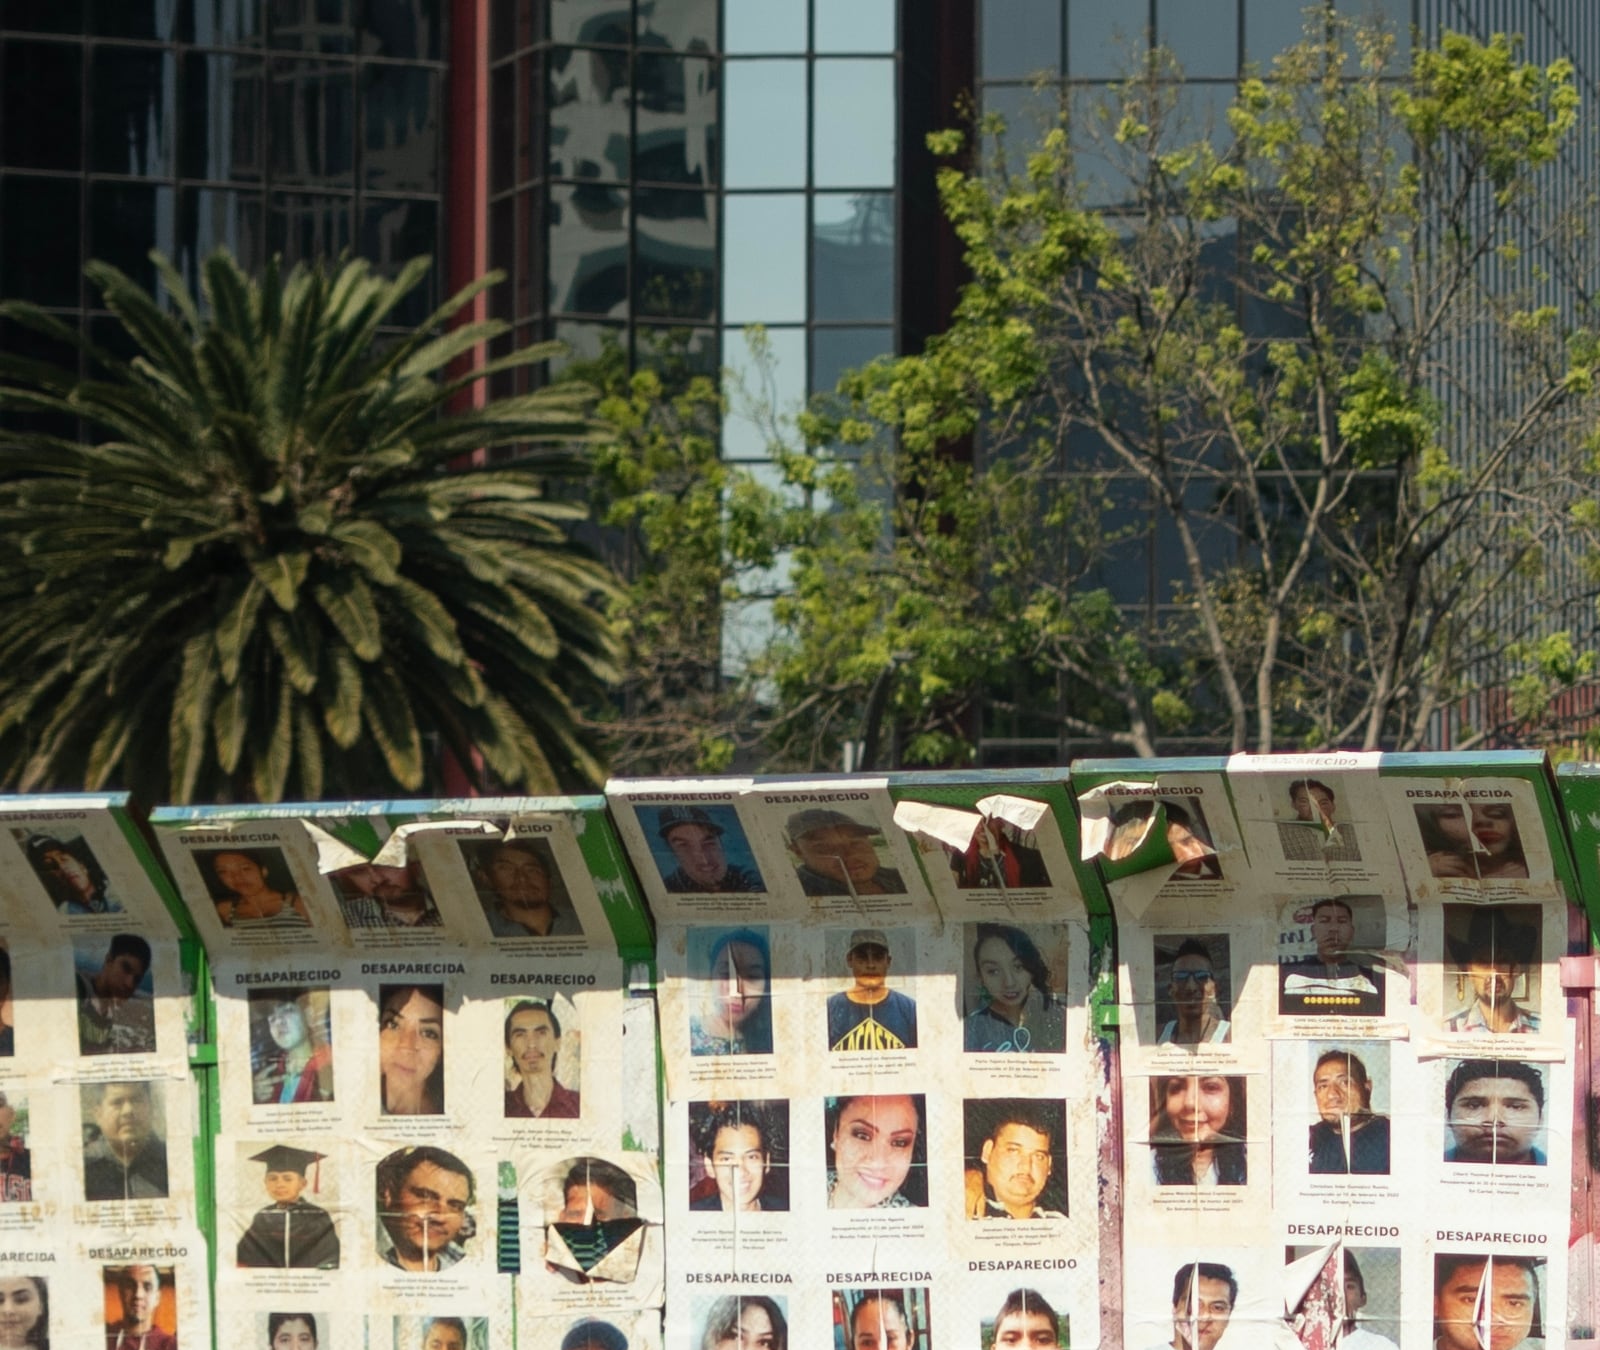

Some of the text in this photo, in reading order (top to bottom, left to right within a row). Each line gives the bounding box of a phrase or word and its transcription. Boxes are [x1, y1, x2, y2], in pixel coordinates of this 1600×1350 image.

[627, 792, 733, 802] DESAPARECIDO
[763, 792, 870, 804] DESAPARECIDO
[179, 832, 281, 845] DESAPARECIDA
[361, 962, 465, 975] DESAPARECIDA
[235, 969, 342, 985] DESAPARECIDO
[490, 973, 596, 986] DESAPARECIDO
[1436, 1230, 1548, 1244] DESAPARECIDO
[88, 1245, 188, 1261] DESAPARECIDO
[968, 1258, 1078, 1272] DESAPARECIDO
[686, 1271, 793, 1284] DESAPARECIDA
[826, 1269, 933, 1284] DESAPARECIDA
